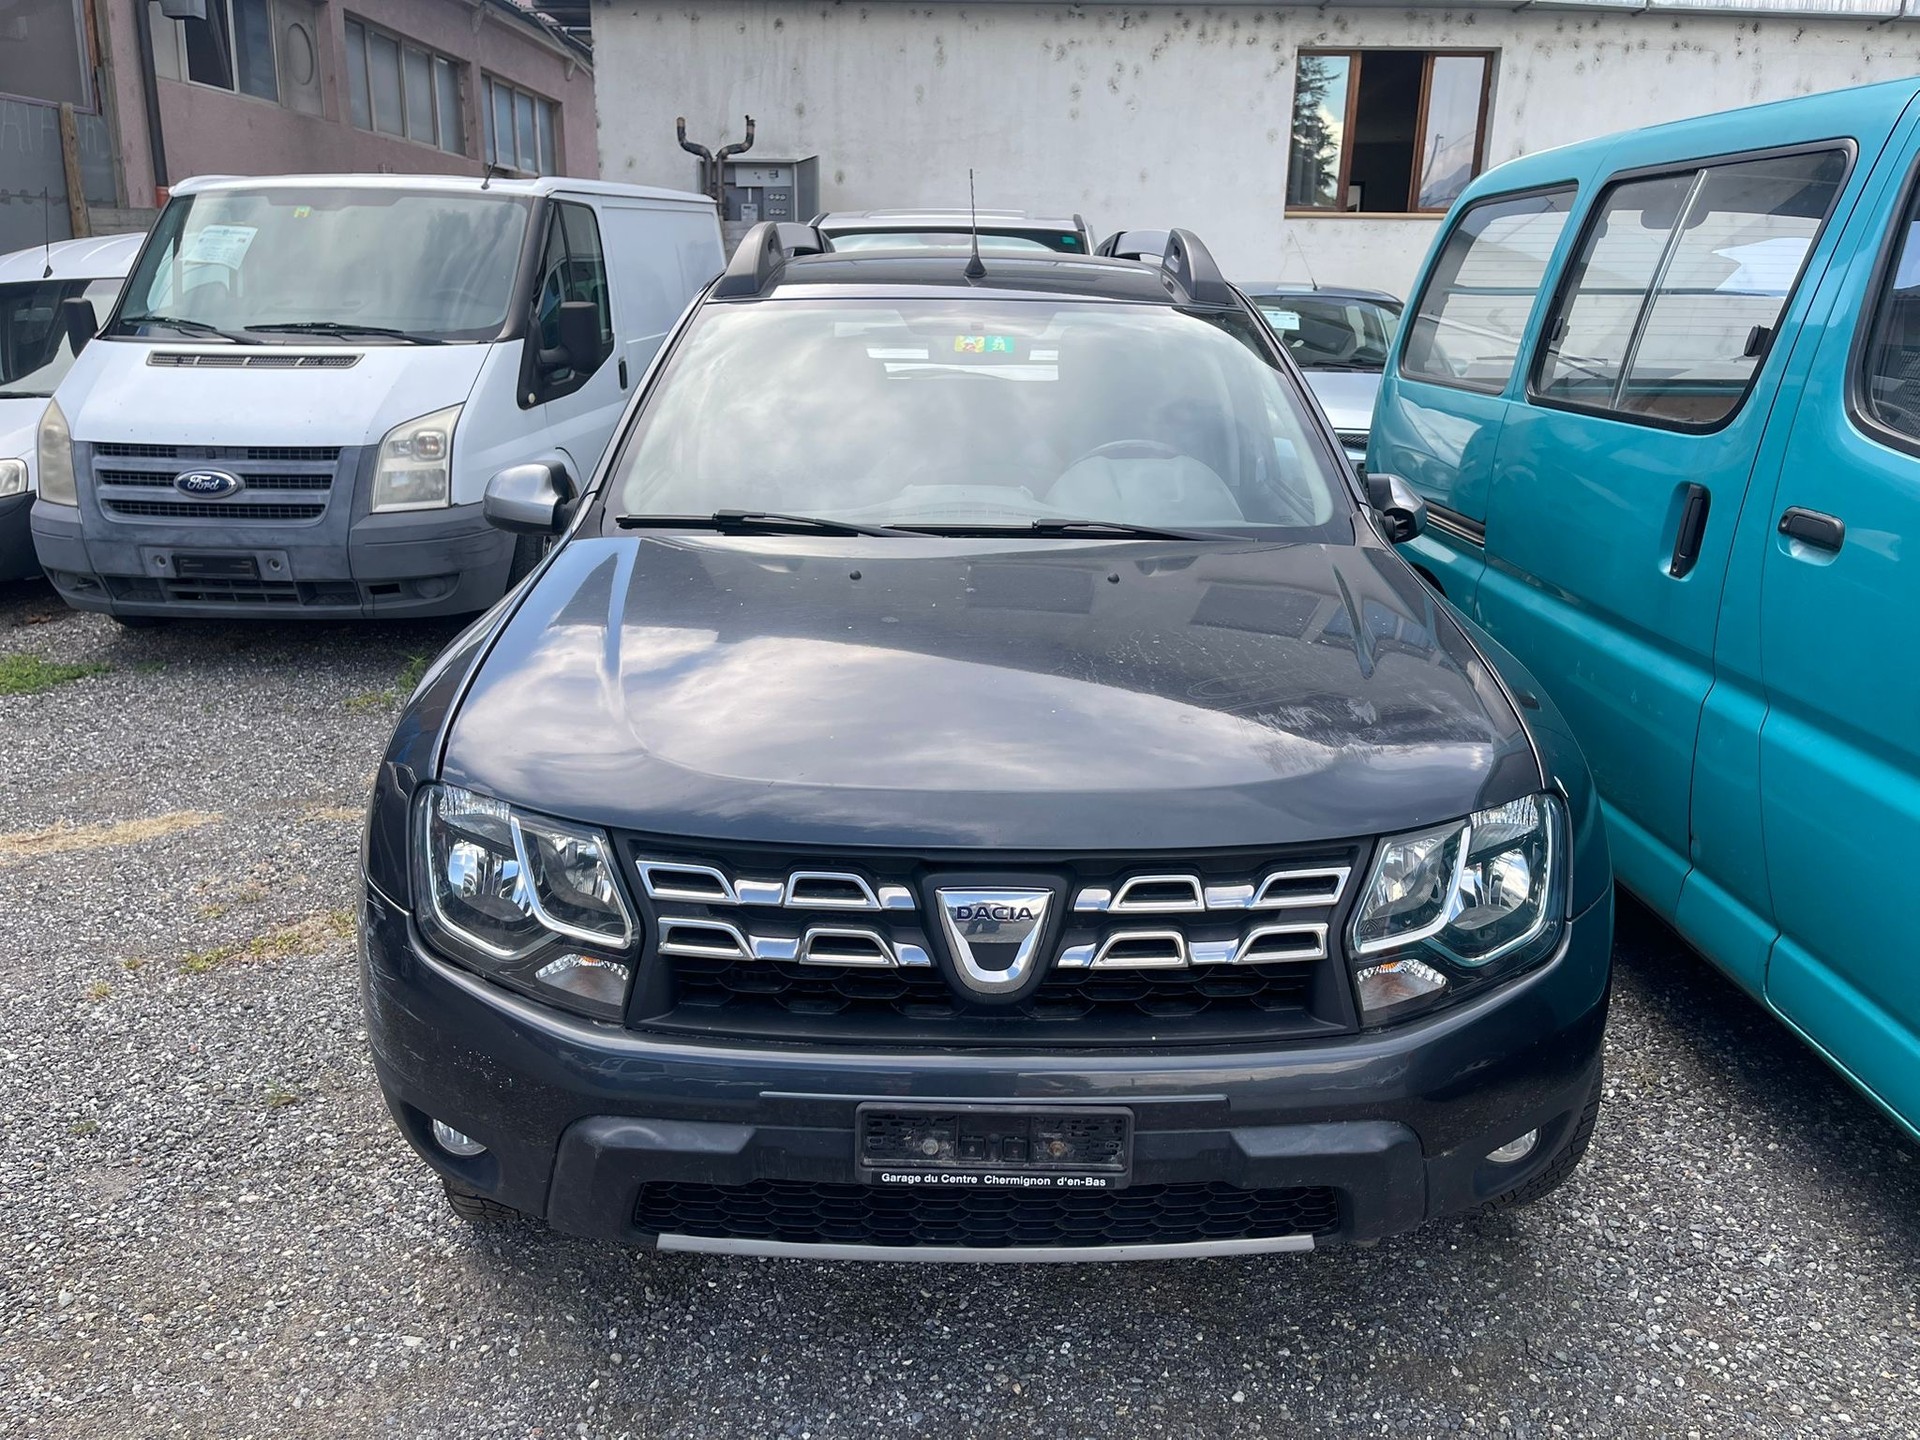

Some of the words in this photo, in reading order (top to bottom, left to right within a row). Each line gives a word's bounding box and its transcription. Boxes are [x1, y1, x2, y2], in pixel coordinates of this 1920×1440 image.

[187, 475, 220, 490] Ford
[956, 906, 1034, 920] DACIA
[881, 1173, 921, 1184] Garage
[924, 1174, 938, 1183] du
[941, 1174, 978, 1184] Centre
[984, 1175, 1051, 1187] Chermignon
[1057, 1177, 1106, 1187] d'en-Bas
